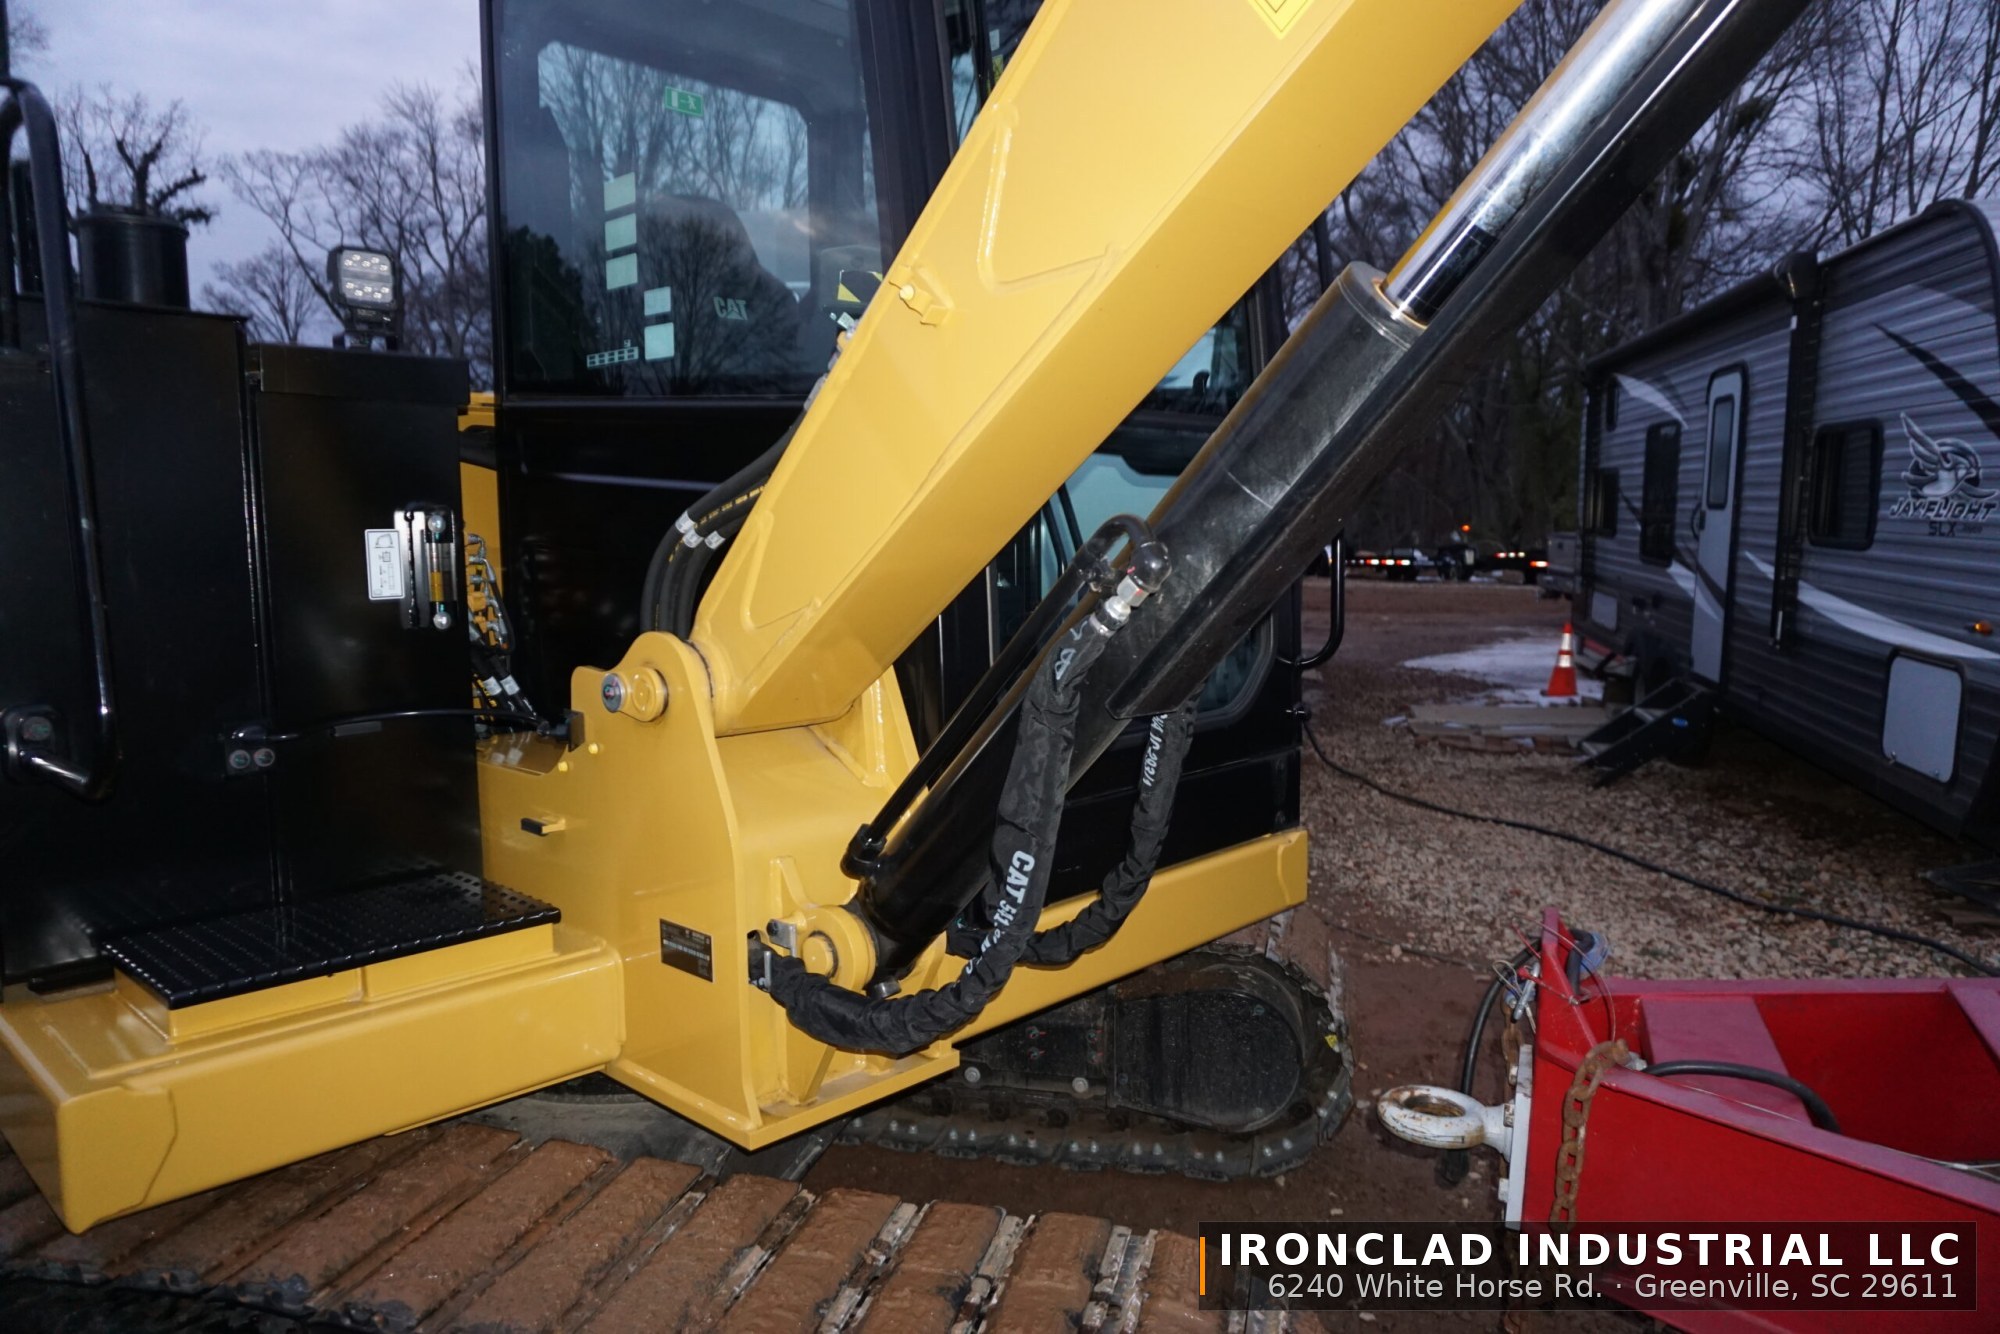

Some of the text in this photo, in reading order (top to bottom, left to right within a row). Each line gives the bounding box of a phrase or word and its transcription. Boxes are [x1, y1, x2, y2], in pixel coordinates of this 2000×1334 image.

[713, 296, 748, 321] CAT
[1929, 521, 1957, 537] SLX
[1004, 850, 1035, 904] CAT
